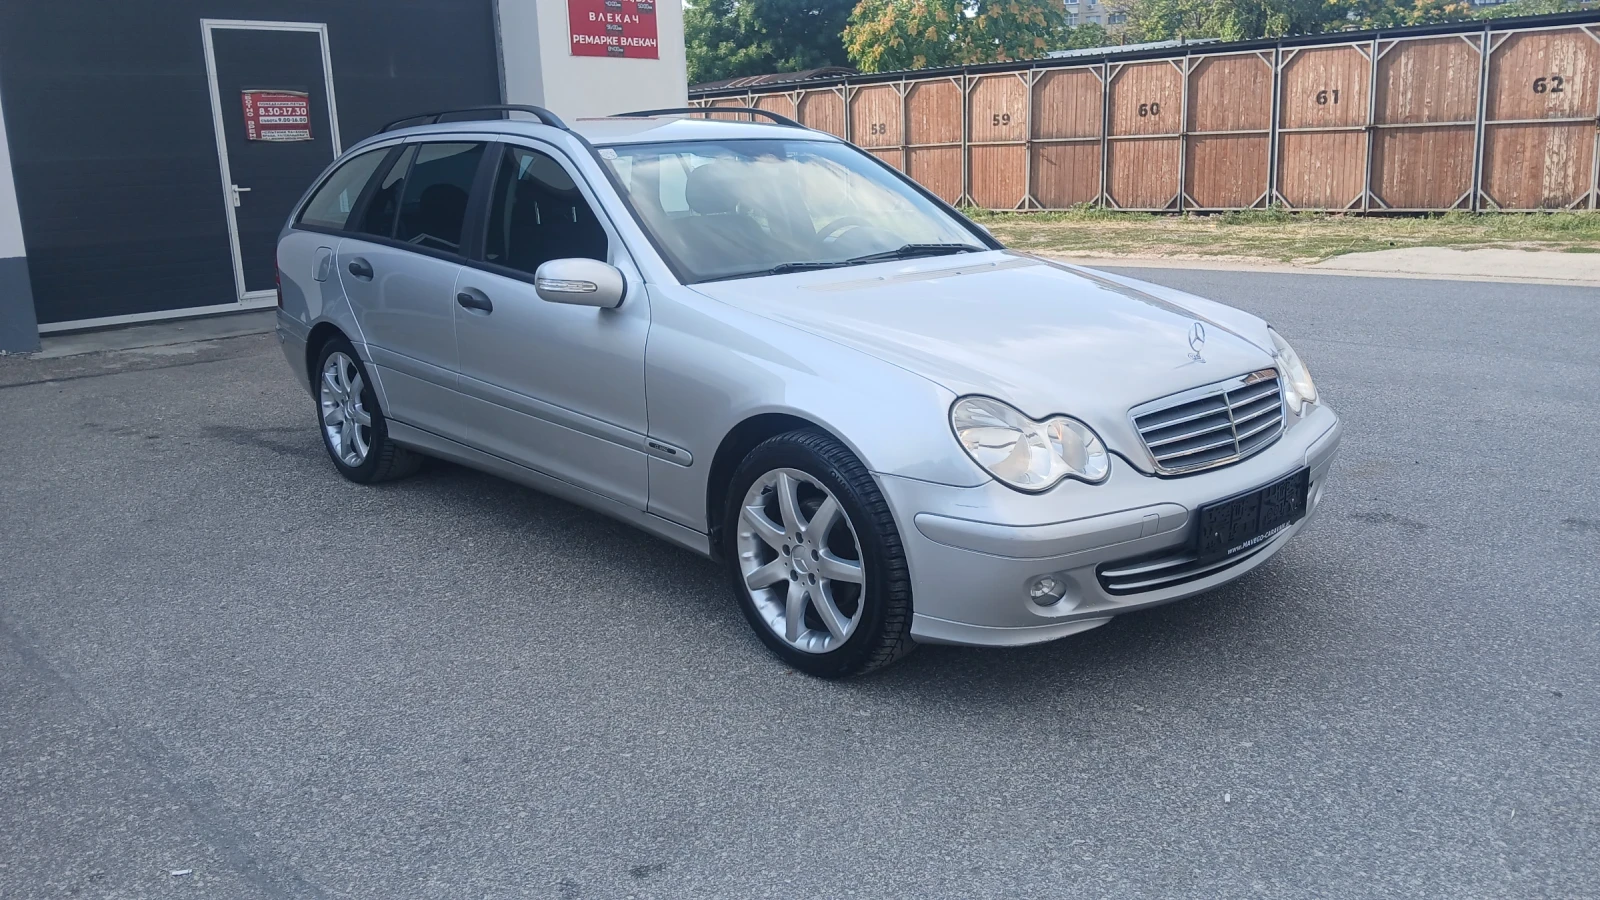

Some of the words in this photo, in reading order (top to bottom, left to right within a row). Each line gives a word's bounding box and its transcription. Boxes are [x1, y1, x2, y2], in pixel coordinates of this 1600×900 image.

[589, 12, 639, 24] ВЛЕКАЧ
[573, 34, 619, 46] РЕМАРКЕ
[620, 37, 657, 48] ВЛЕКАЧ
[1533, 76, 1564, 94] 62
[1316, 89, 1340, 105] 61
[1138, 102, 1161, 117] 60
[992, 113, 1011, 126] 59
[871, 123, 886, 135] 58
